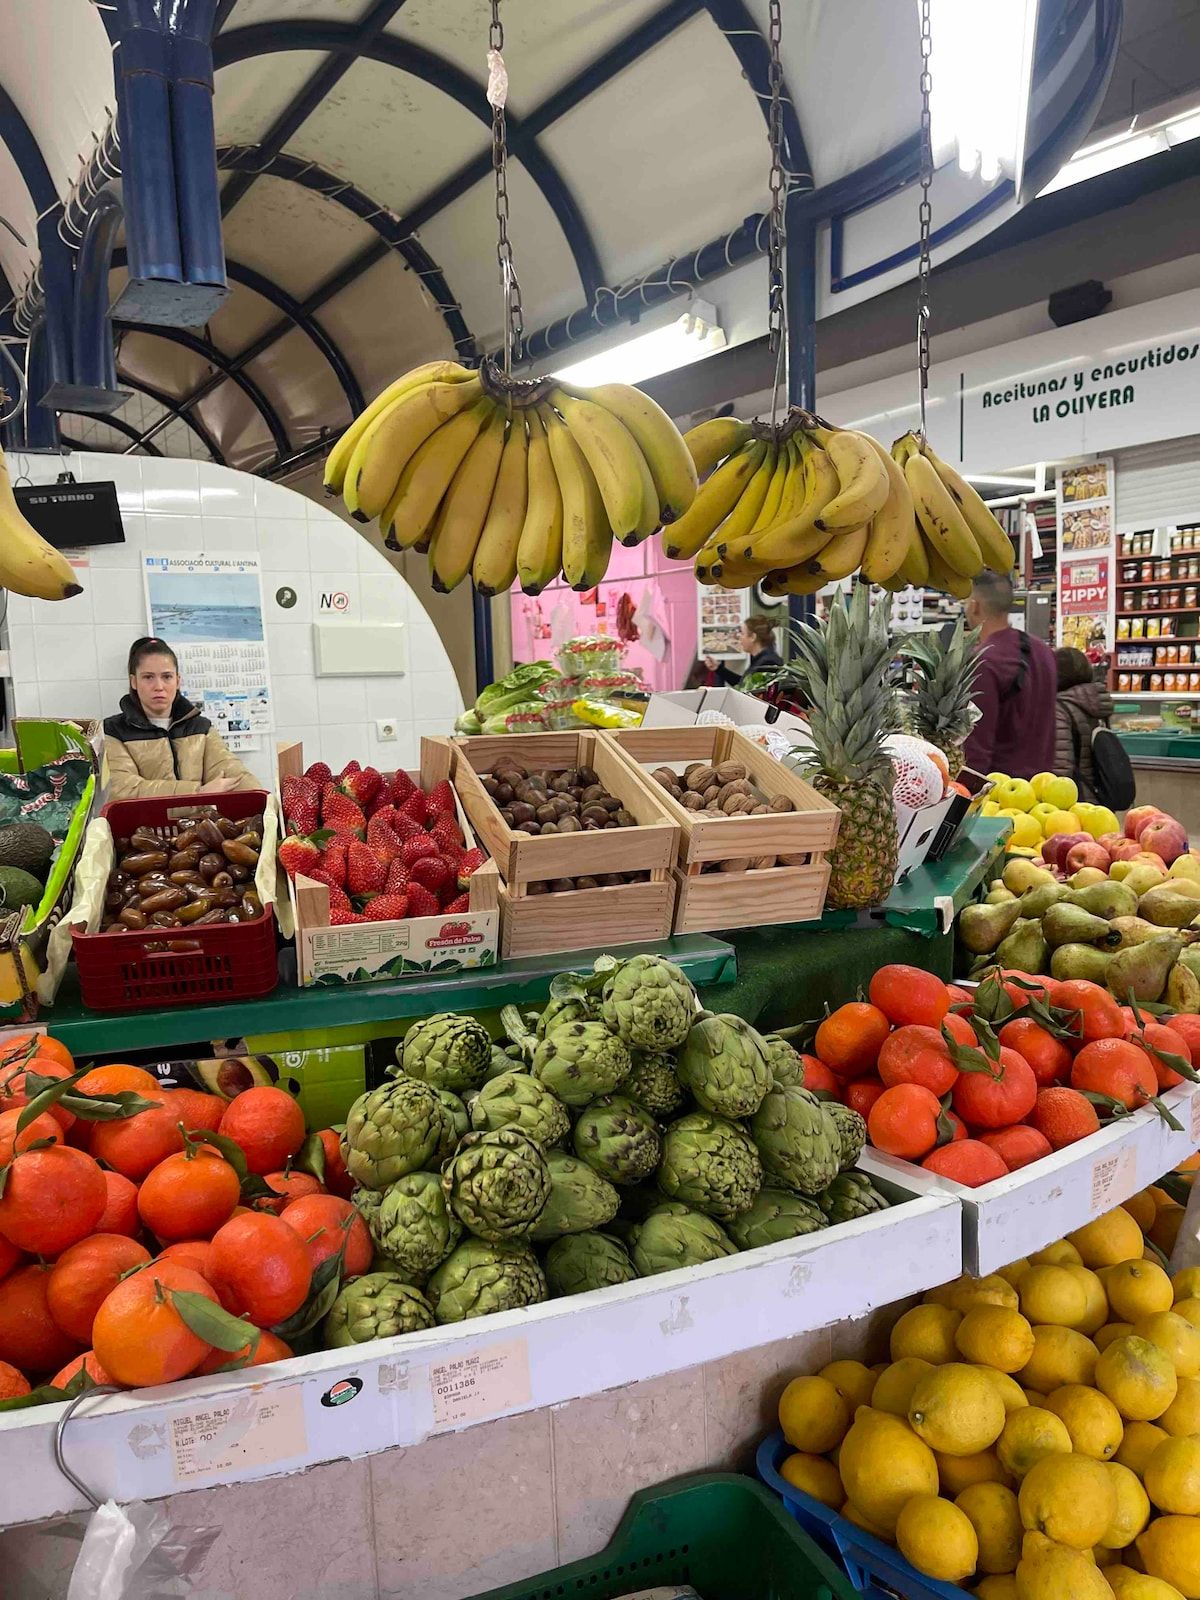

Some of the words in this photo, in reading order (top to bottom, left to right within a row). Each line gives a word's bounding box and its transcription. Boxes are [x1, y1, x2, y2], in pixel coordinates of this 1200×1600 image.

[983, 376, 1067, 408] Aceitunas
[1074, 371, 1084, 391] y
[1091, 344, 1200, 382] encurtidos
[1033, 404, 1050, 423] LA
[1056, 385, 1135, 418] OLIVERA
[50, 494, 94, 502] TURNO
[1062, 586, 1106, 602] ZIPPY
